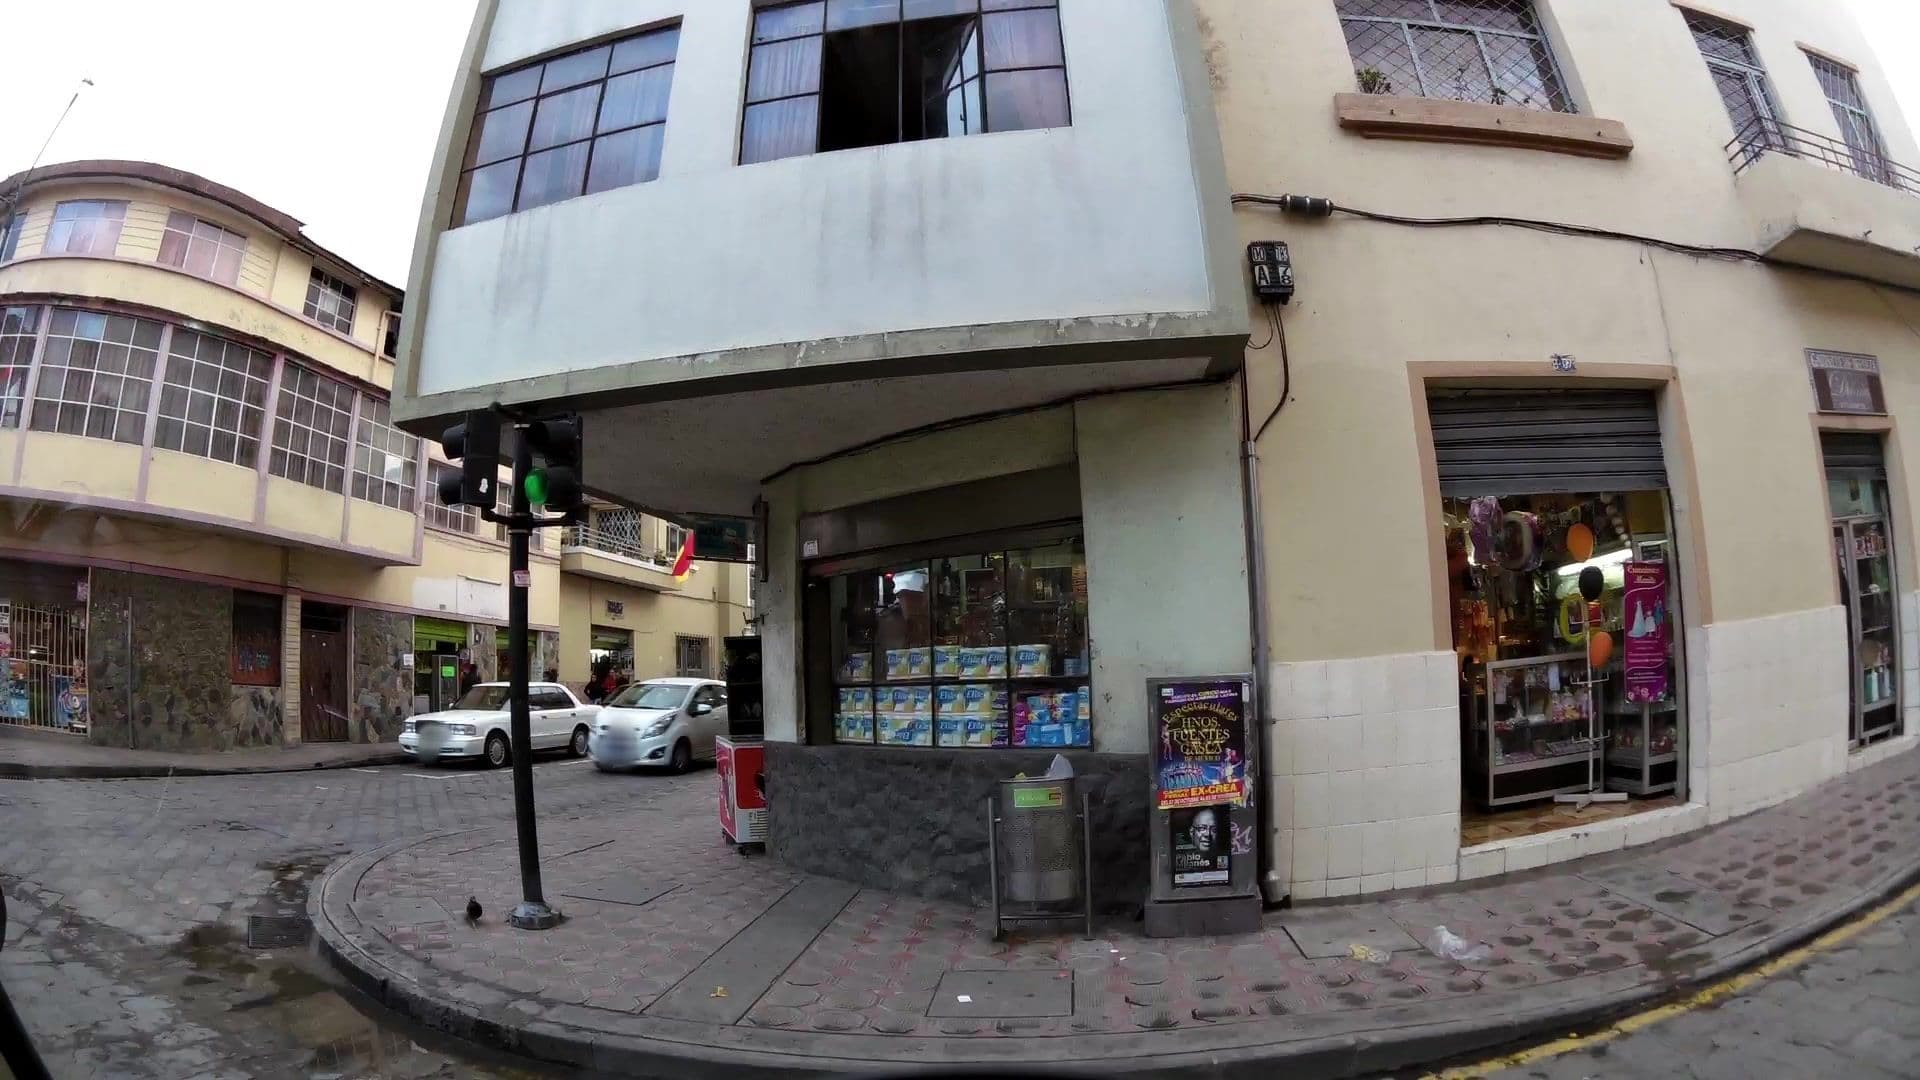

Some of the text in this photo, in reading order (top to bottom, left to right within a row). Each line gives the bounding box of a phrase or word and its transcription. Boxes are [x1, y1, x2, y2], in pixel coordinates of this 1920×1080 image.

[1162, 702, 1238, 723] Espectaculares
[1181, 716, 1221, 729] HNOS.
[1170, 728, 1231, 742] FUENTES
